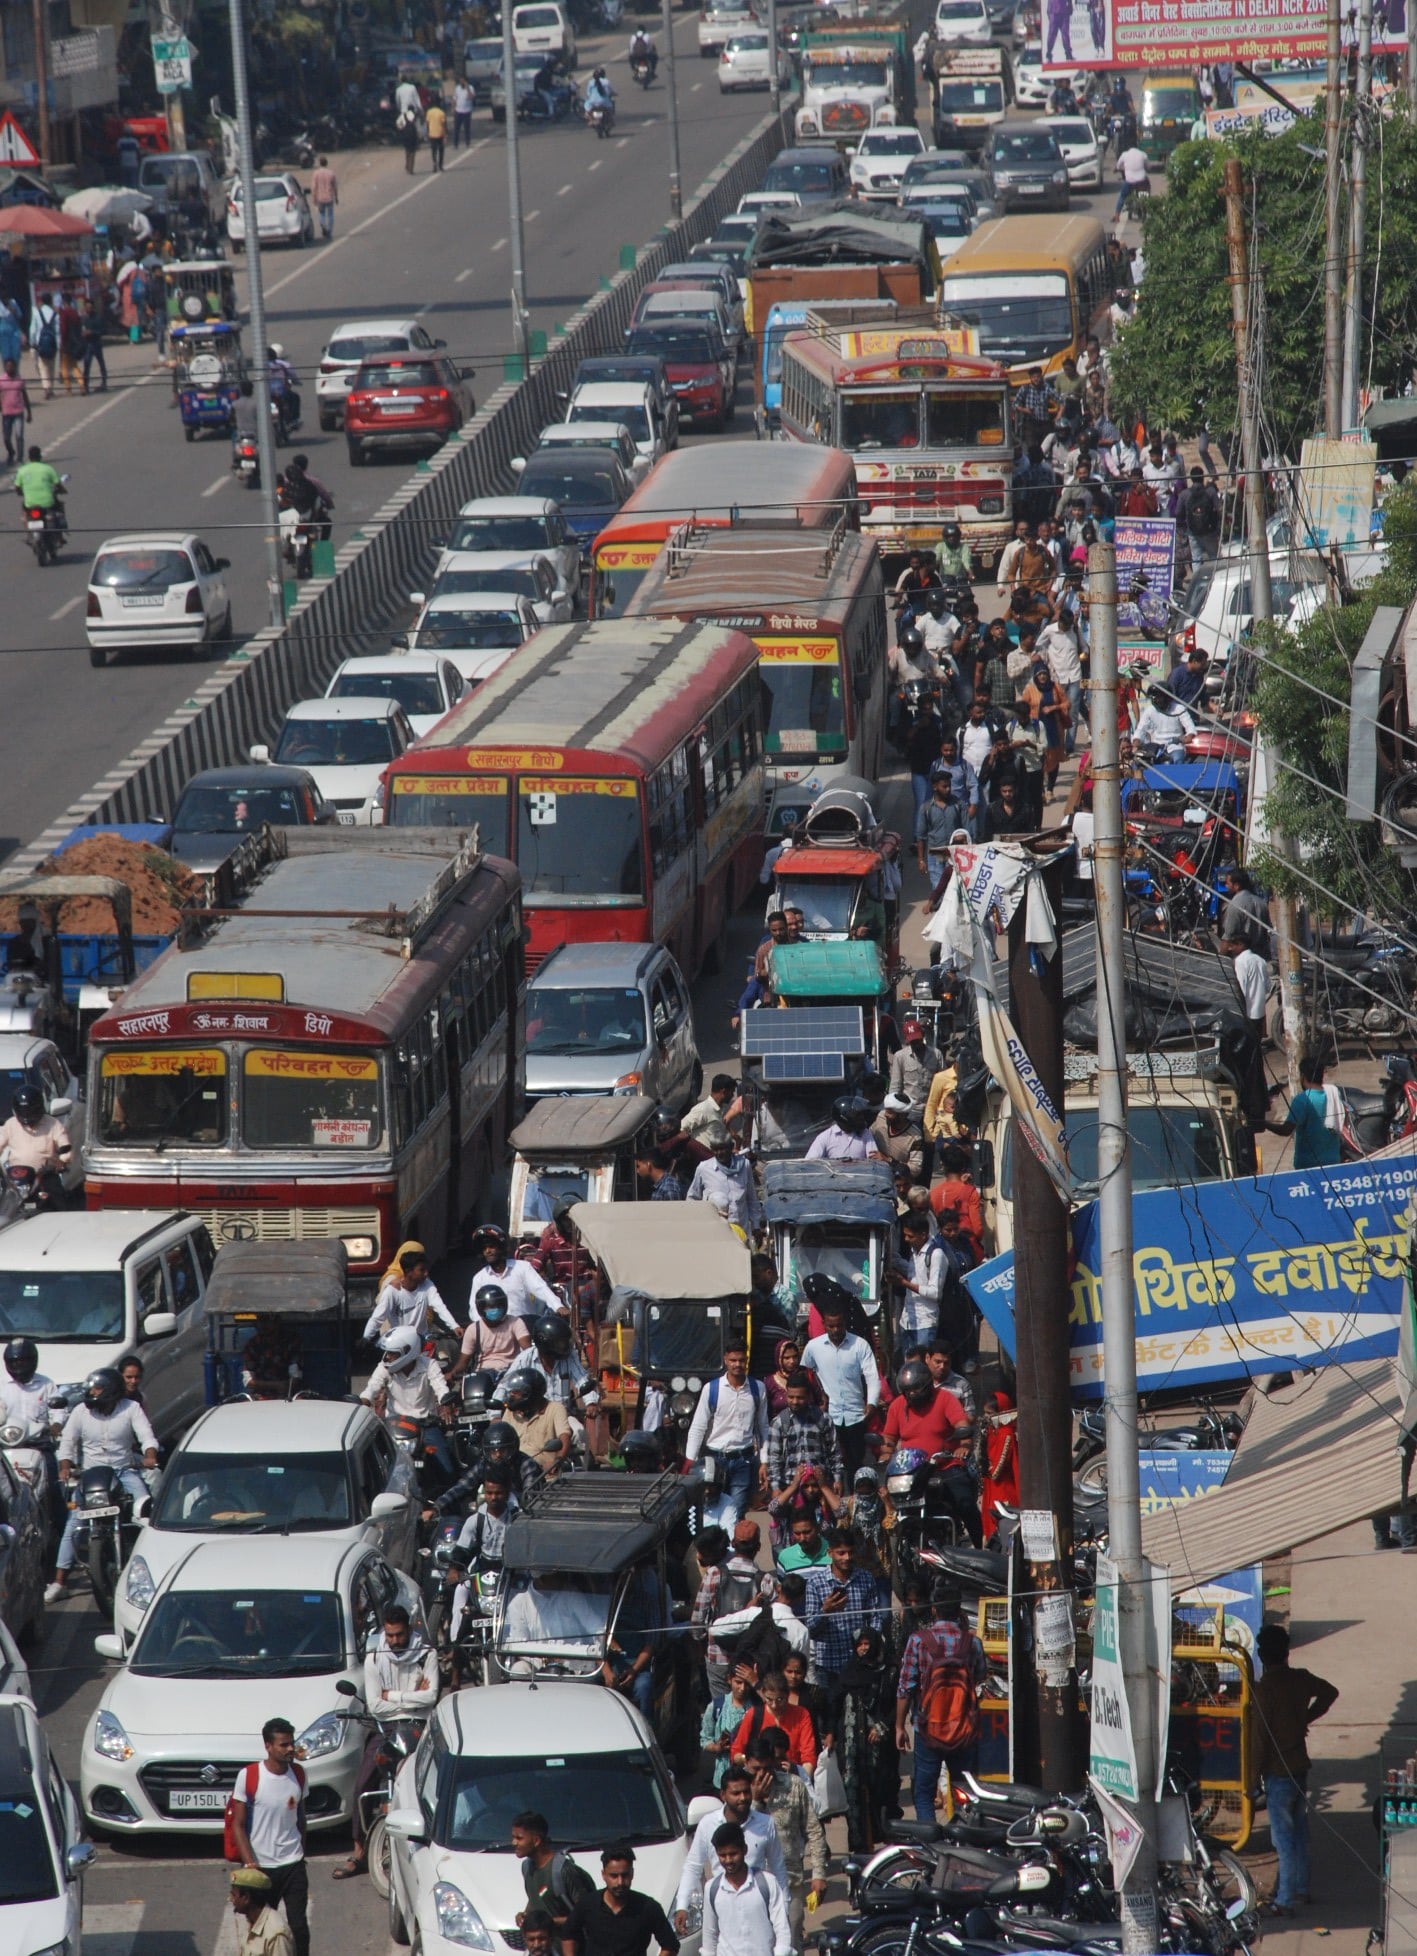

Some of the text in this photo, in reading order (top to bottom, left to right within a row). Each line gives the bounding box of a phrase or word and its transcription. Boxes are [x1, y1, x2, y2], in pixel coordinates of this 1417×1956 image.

[1235, 0, 1246, 16] IN
[1249, 0, 1279, 15] DELHI
[1282, 0, 1304, 14] NCR
[1189, 44, 1200, 58] के
[913, 470, 938, 479] TATA
[769, 615, 818, 630] डिपो मेरठ
[531, 753, 555, 767] डिपो
[424, 777, 599, 793] उत्तर प्रदेश परिवहन
[118, 1012, 172, 1036] सहारनपुर
[233, 1013, 270, 1030] शिवाय
[305, 1012, 333, 1035] डिपो
[150, 1053, 219, 1074] उत्तर प्रदेश
[260, 1056, 333, 1074] परिवहन
[1288, 1181, 1315, 1198] मो.
[1184, 1332, 1210, 1357] के
[1219, 1327, 1296, 1353] अन्दर
[1094, 1685, 1122, 1731] B.Tech
